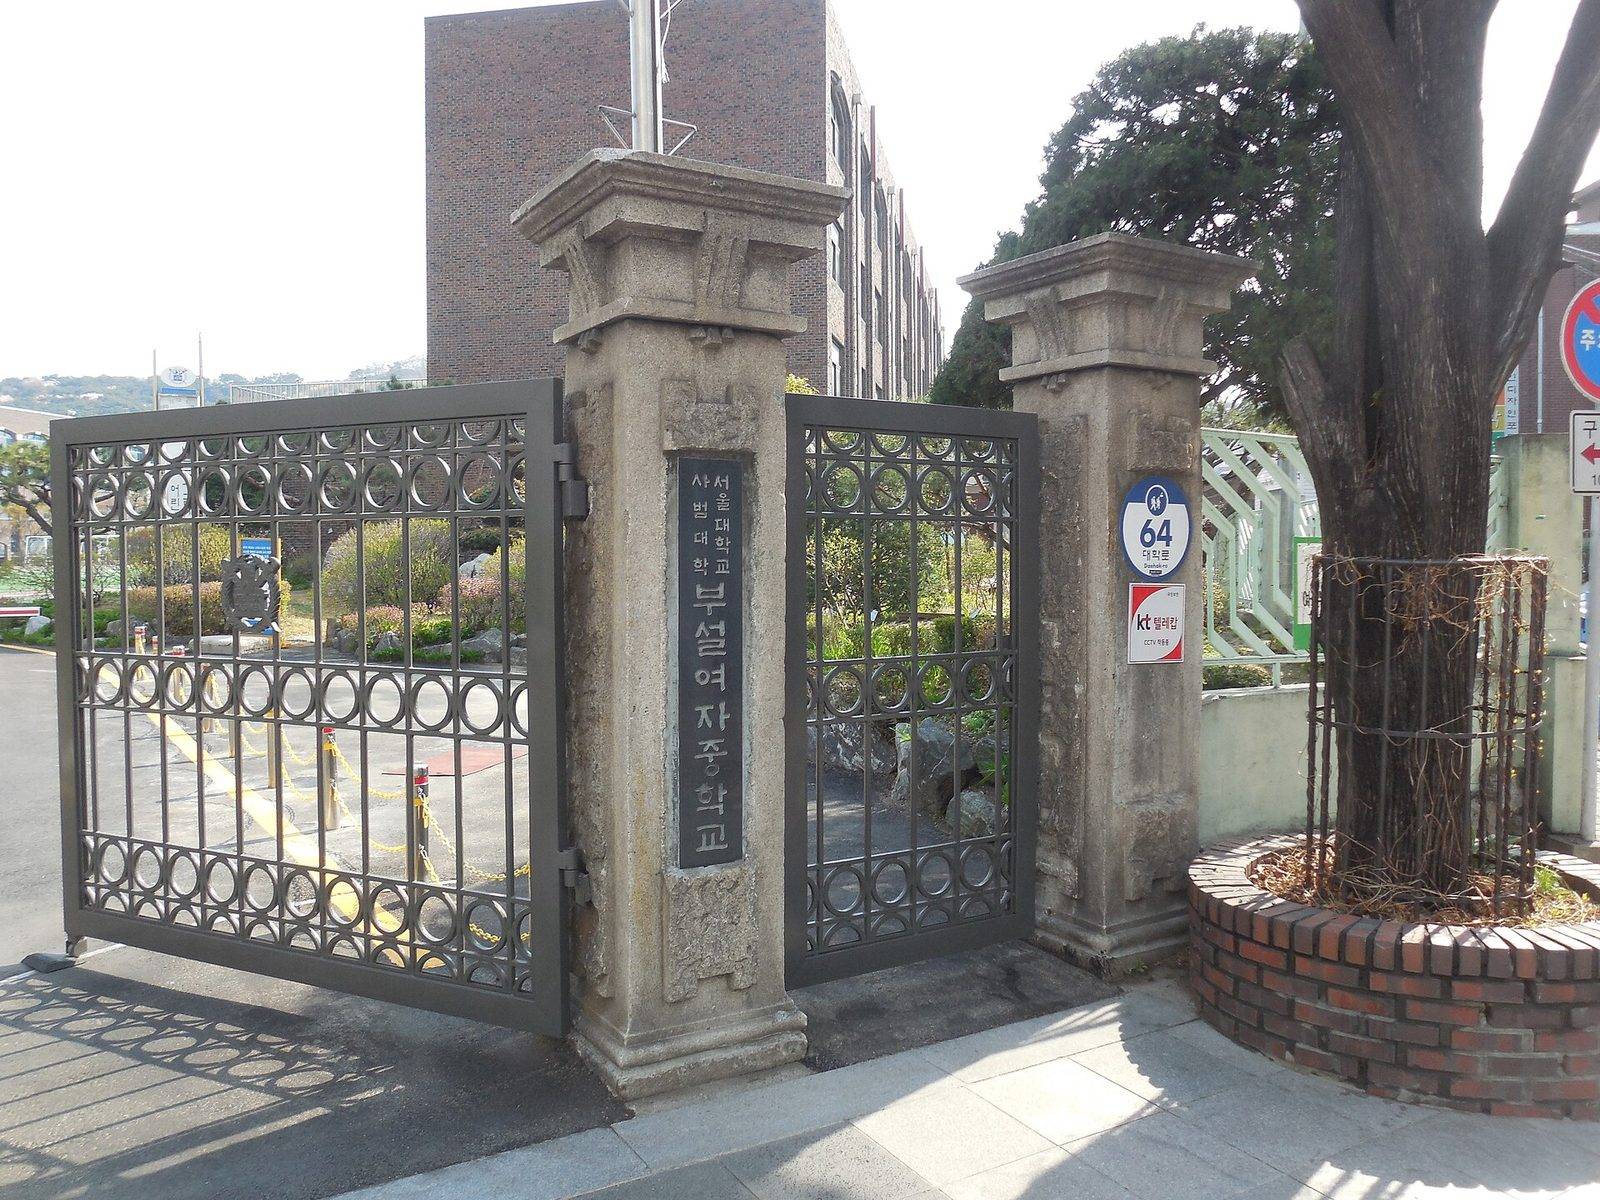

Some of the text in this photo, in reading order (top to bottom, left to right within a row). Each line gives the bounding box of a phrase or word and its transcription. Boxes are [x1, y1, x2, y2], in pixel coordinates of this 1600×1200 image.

[1580, 328, 1600, 351] 주
[692, 473, 711, 576] 사범대학
[714, 474, 731, 575] 서울대학교
[1140, 519, 1172, 548] 64
[1142, 550, 1169, 561] 대학로
[1137, 614, 1178, 630] kt 텔레캅
